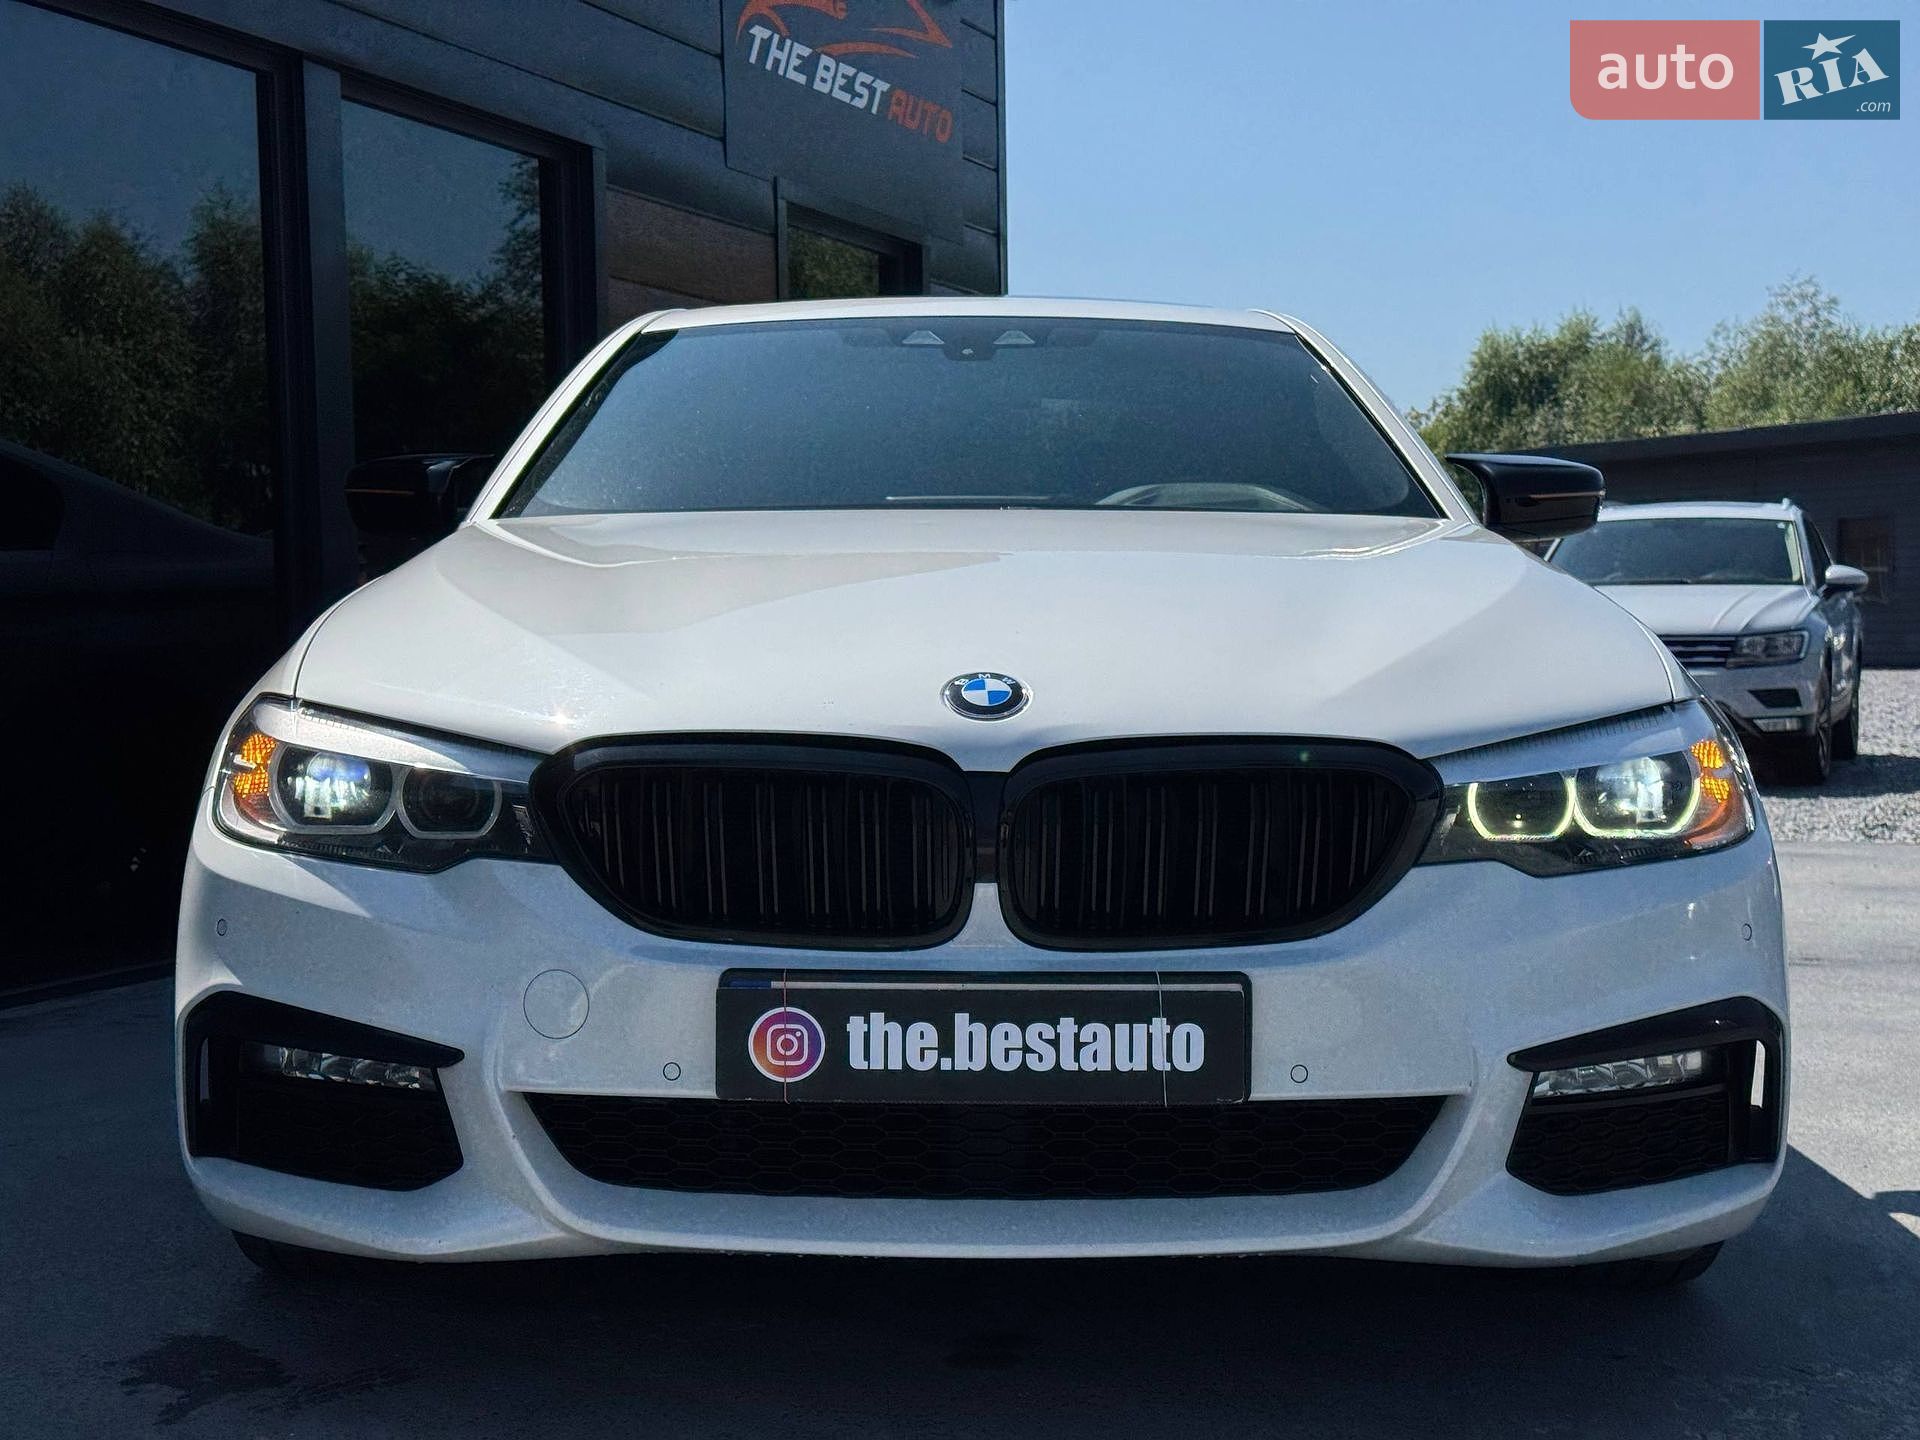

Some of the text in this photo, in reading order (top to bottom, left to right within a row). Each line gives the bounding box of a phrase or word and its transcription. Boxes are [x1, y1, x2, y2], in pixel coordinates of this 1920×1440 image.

[749, 25, 953, 143] THE BEST AUTO
[954, 673, 1016, 685] BMW
[847, 1012, 1205, 1072] the.bestauto
